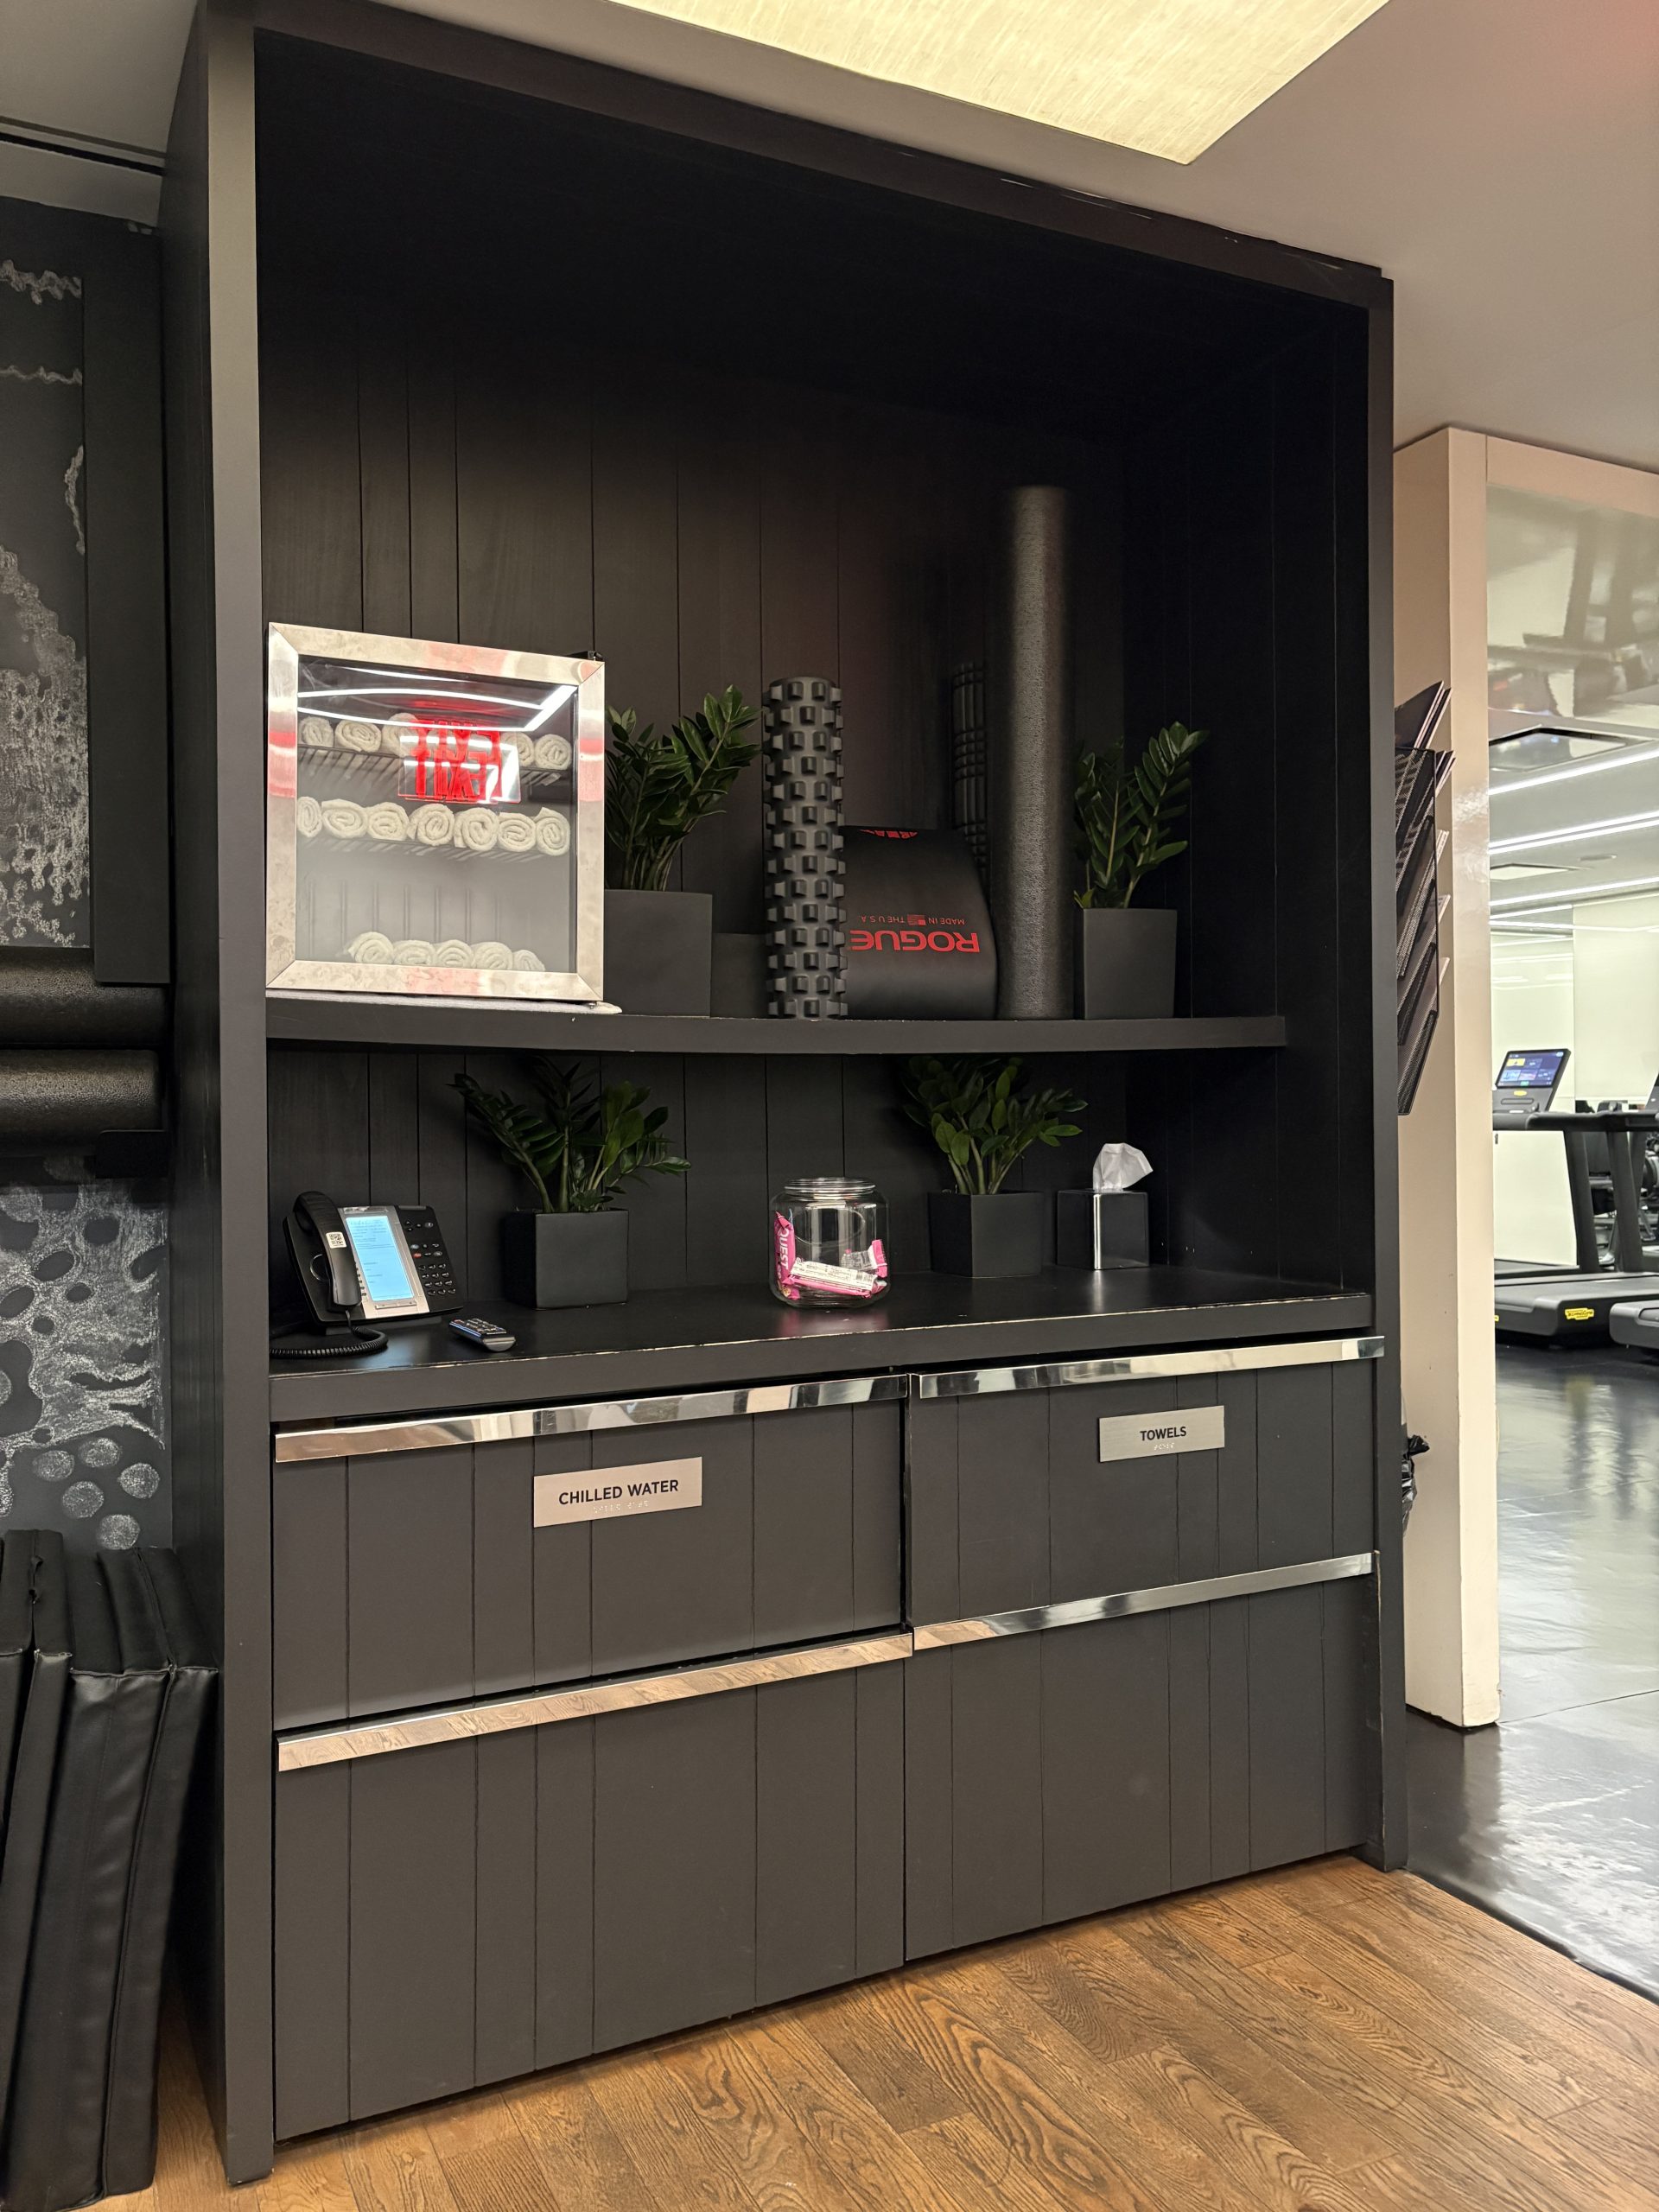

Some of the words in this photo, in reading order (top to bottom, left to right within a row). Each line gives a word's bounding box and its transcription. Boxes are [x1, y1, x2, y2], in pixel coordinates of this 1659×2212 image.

[850, 930, 980, 953] ROGUE
[779, 1227, 790, 1270] QUEST
[1140, 1426, 1187, 1441] TOWELS
[558, 1485, 623, 1505] CHILLED
[627, 1479, 679, 1497] WATER
